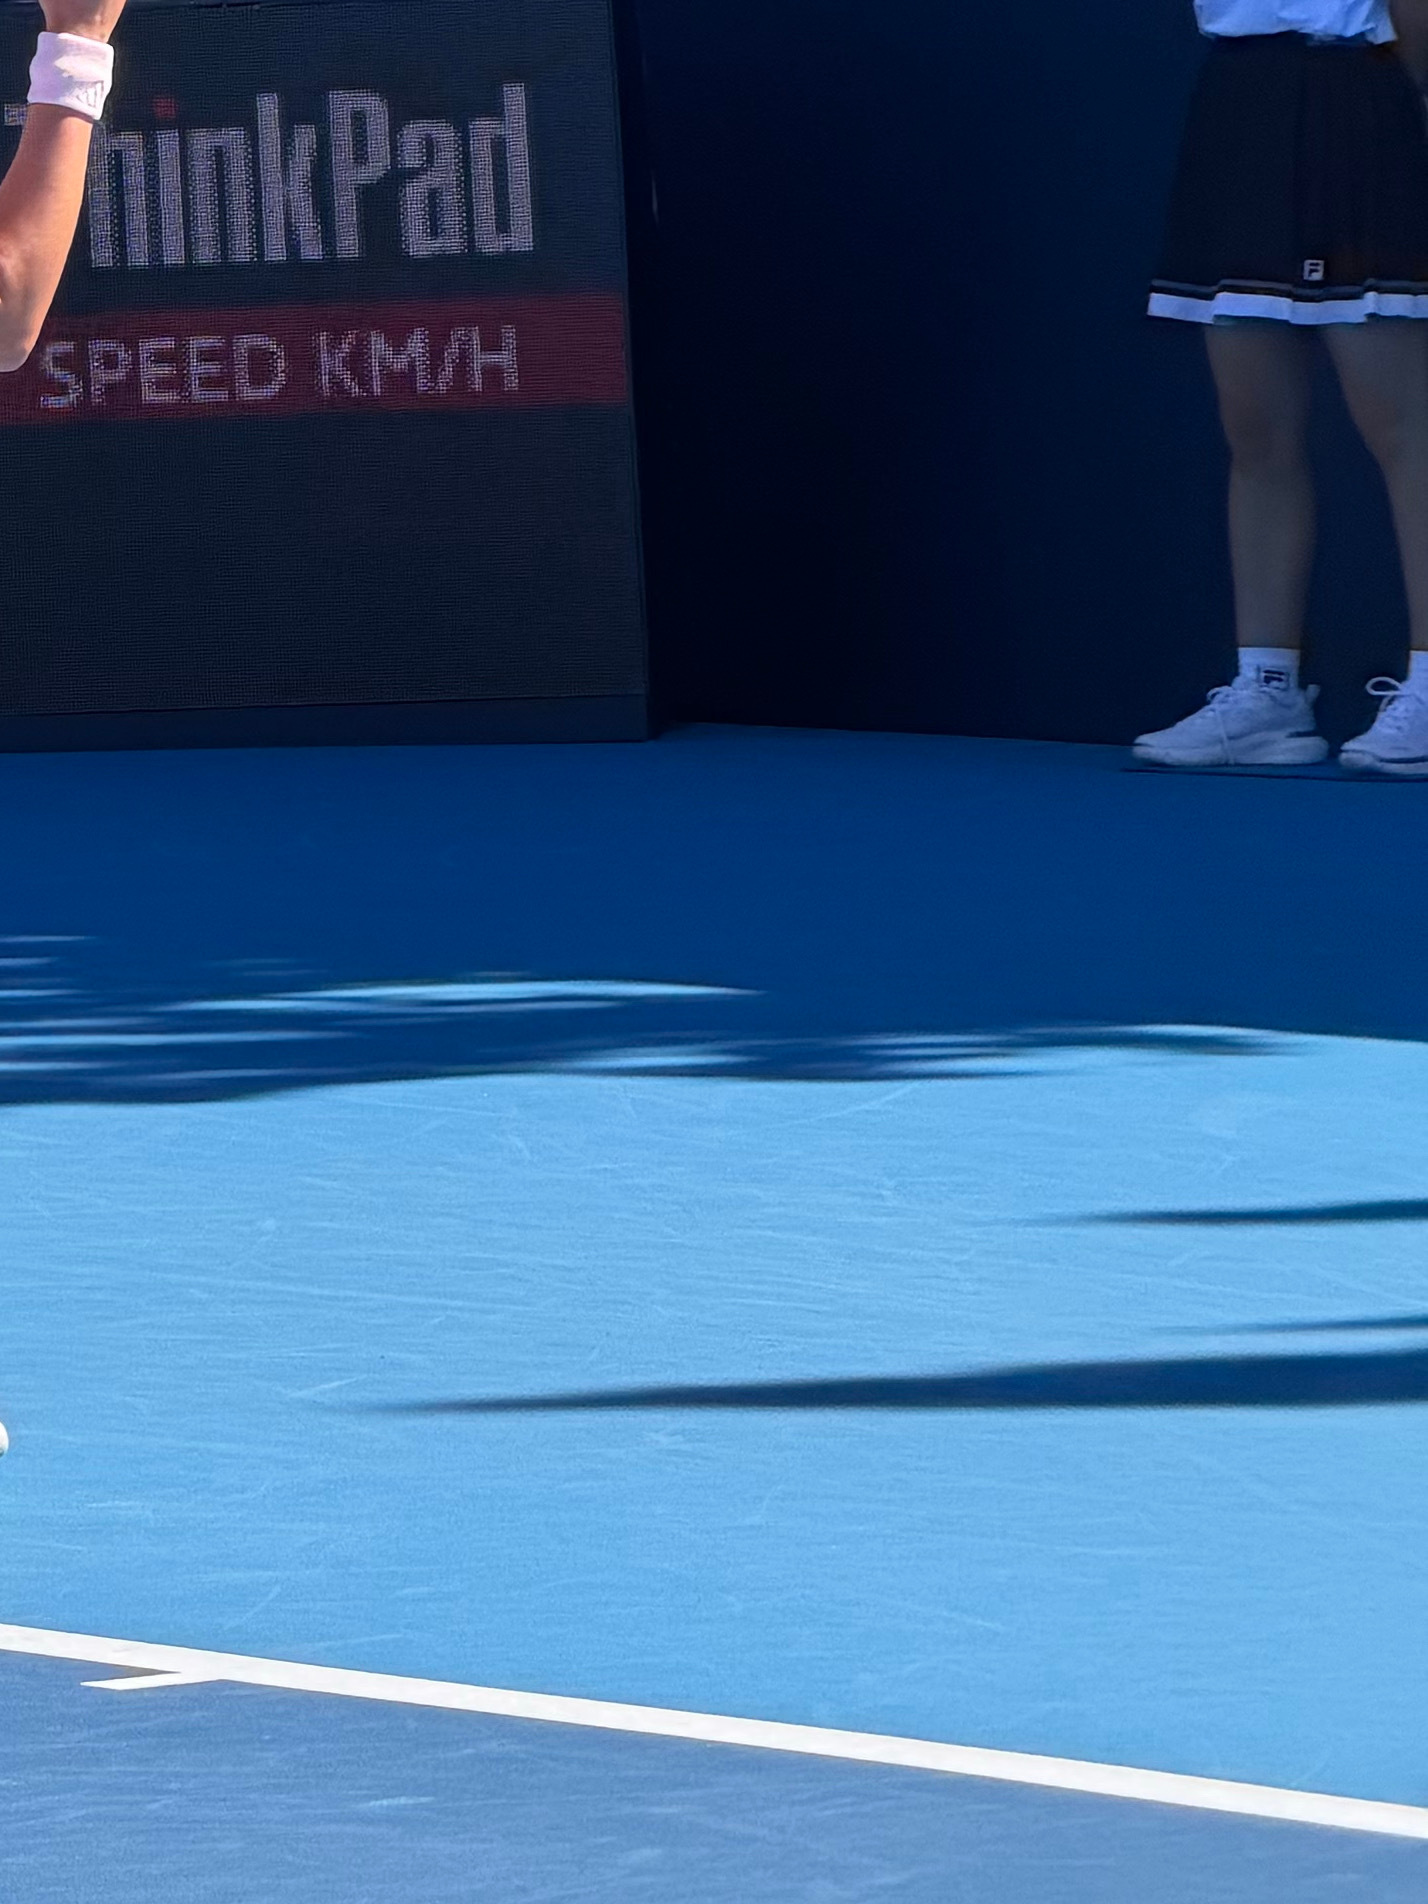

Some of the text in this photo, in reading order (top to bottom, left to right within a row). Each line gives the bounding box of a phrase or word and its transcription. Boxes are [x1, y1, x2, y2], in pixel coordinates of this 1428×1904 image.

[3, 82, 535, 271] hinkPad
[40, 324, 519, 409] SPEED KM/H
